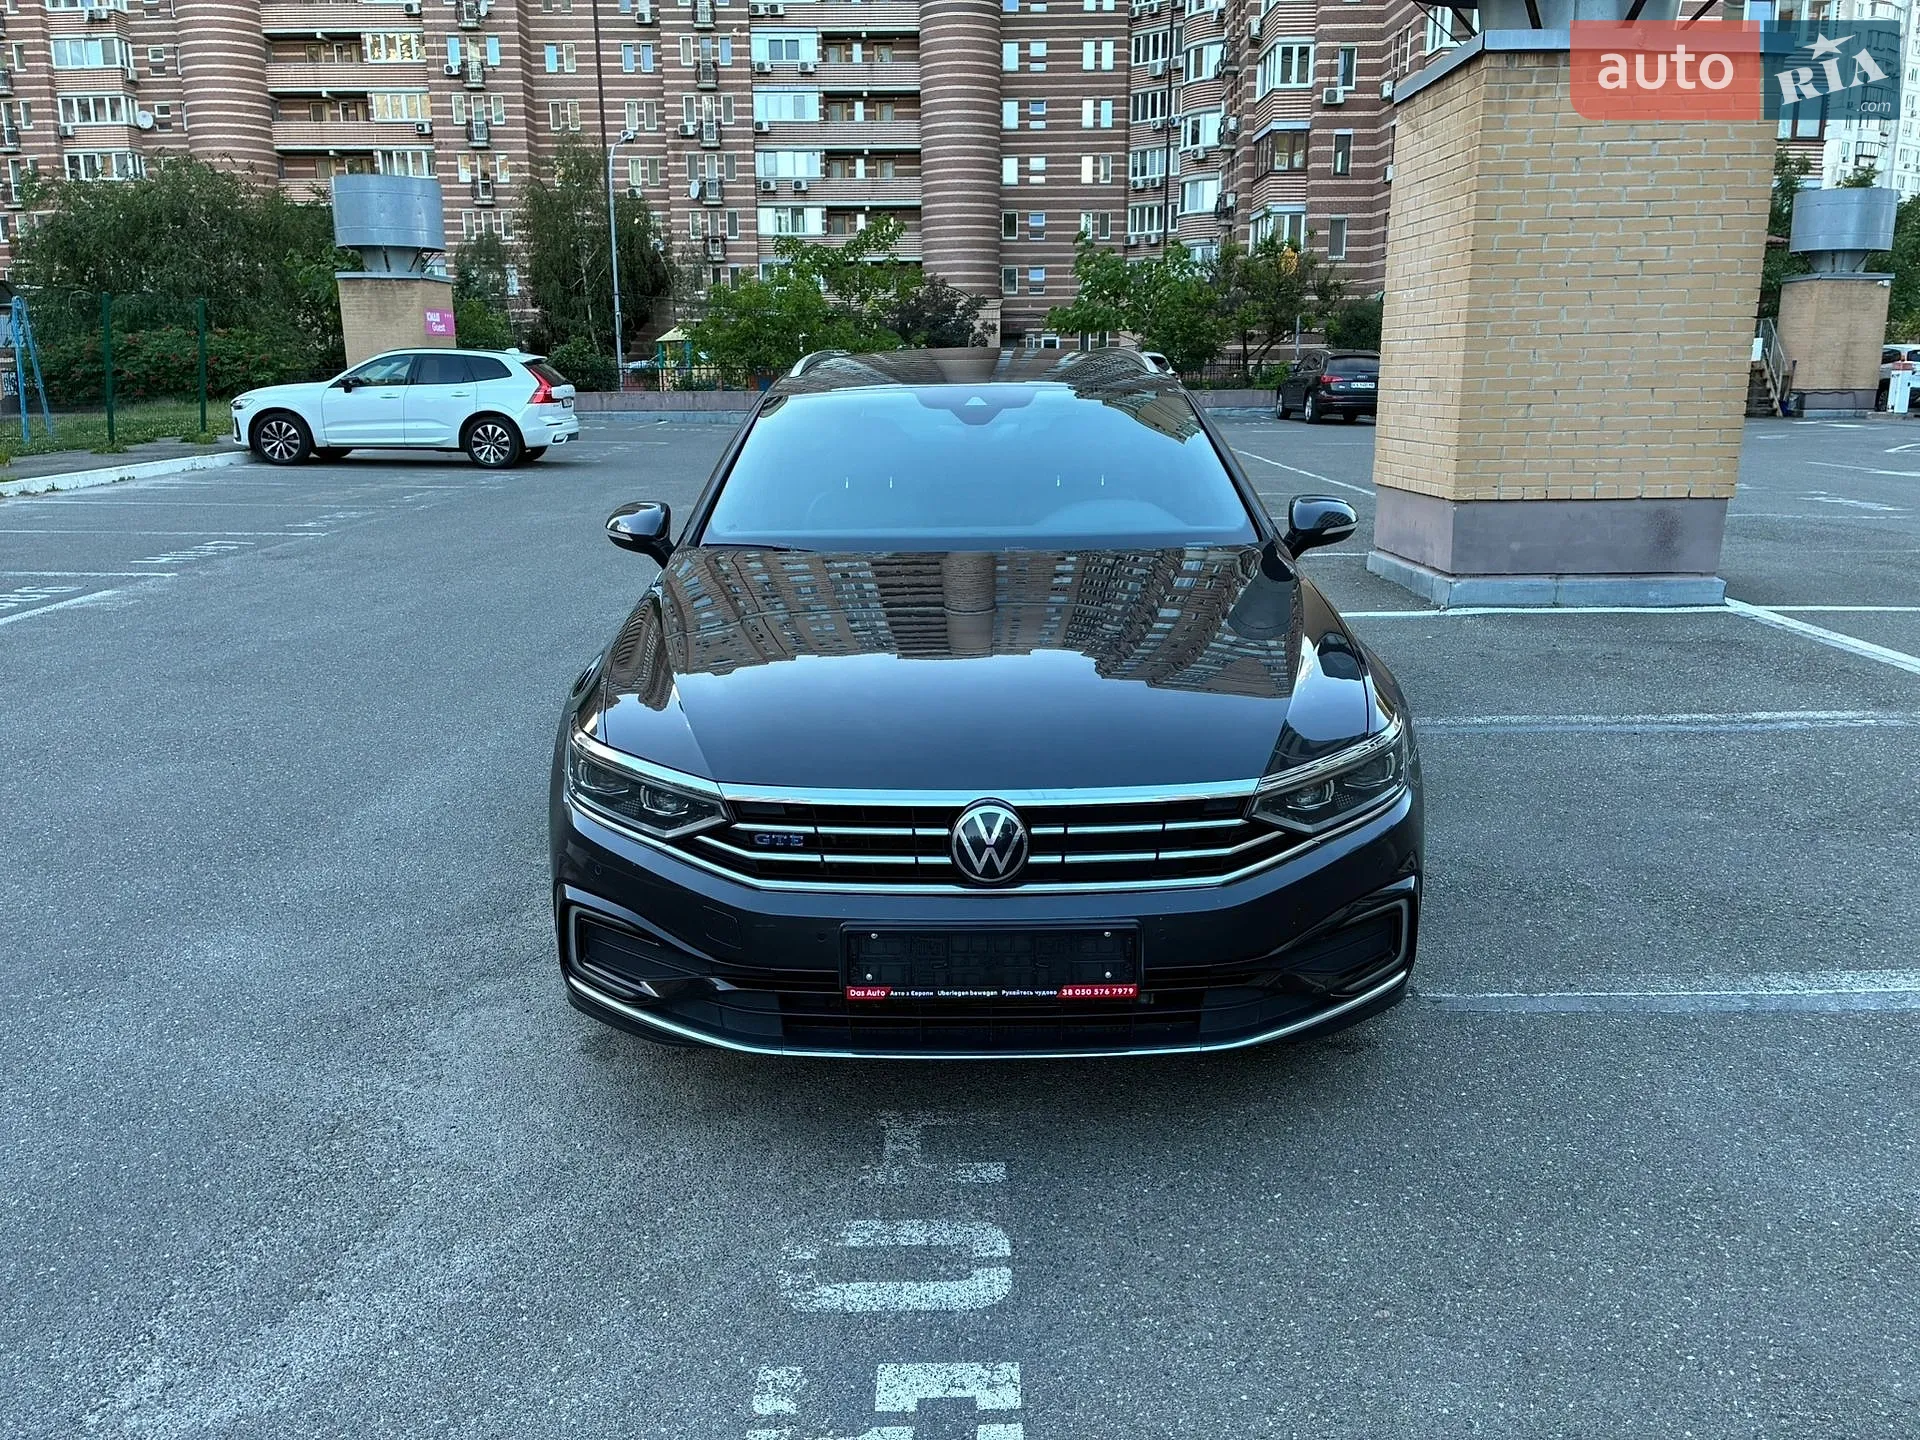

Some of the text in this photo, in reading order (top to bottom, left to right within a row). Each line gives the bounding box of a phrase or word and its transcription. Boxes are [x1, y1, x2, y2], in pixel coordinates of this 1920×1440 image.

[754, 833, 804, 847] GTE
[866, 989, 886, 997] Auto
[1062, 987, 1134, 997] 38 050 576 7979
